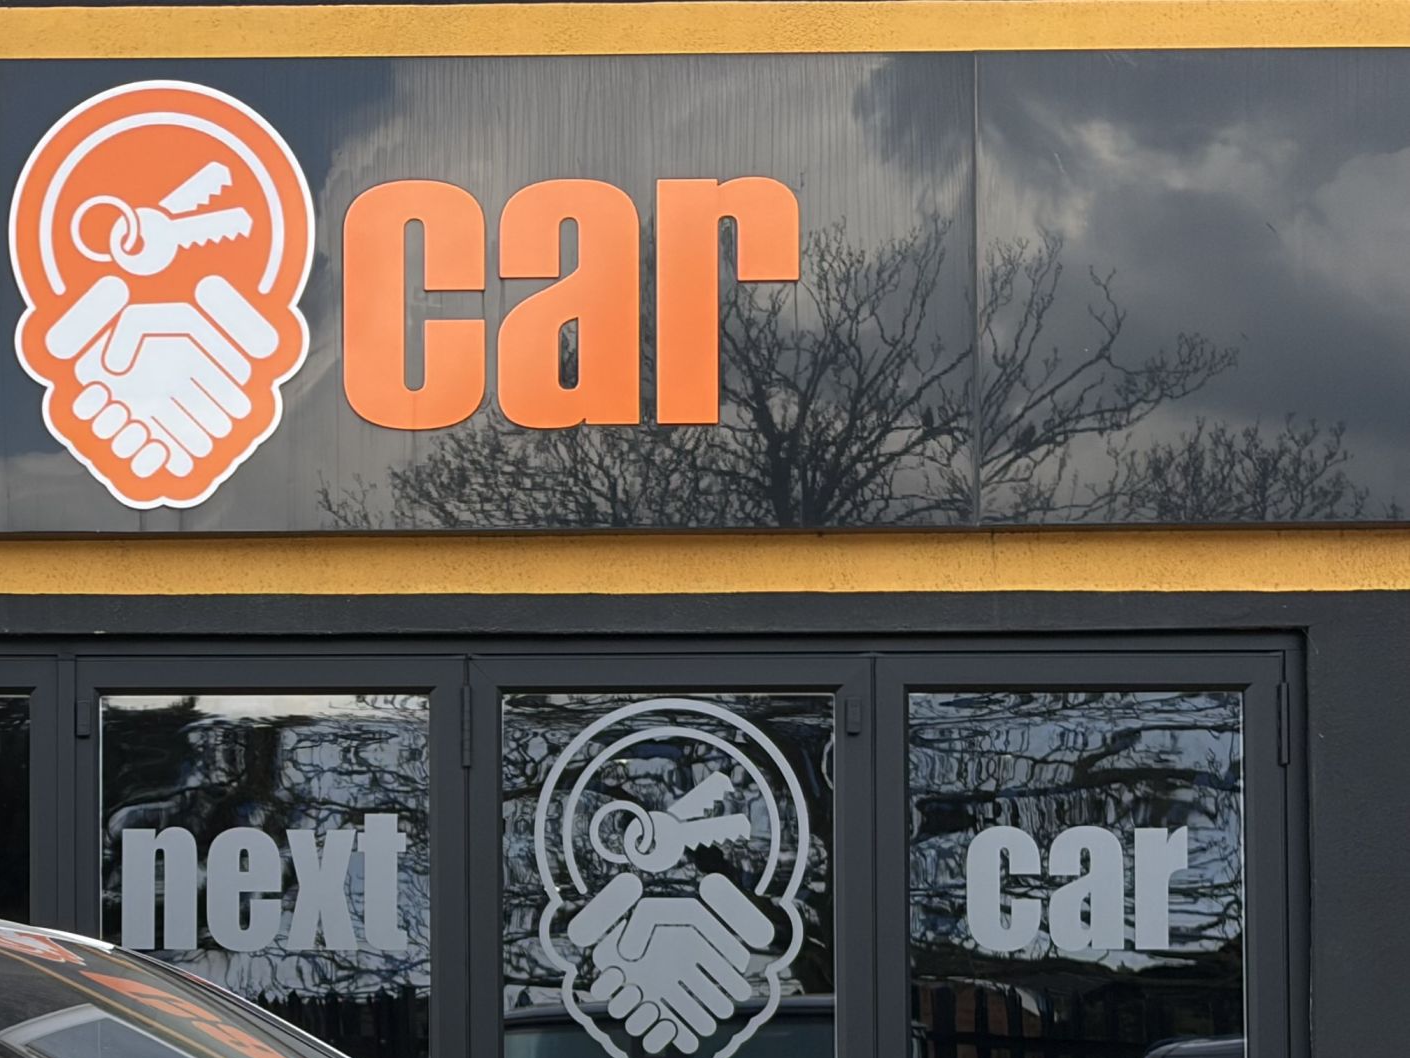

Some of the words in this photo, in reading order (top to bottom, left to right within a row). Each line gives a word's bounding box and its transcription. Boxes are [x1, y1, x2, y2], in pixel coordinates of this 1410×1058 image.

[343, 176, 800, 430] car
[122, 813, 407, 951] next
[966, 825, 1189, 951] car
